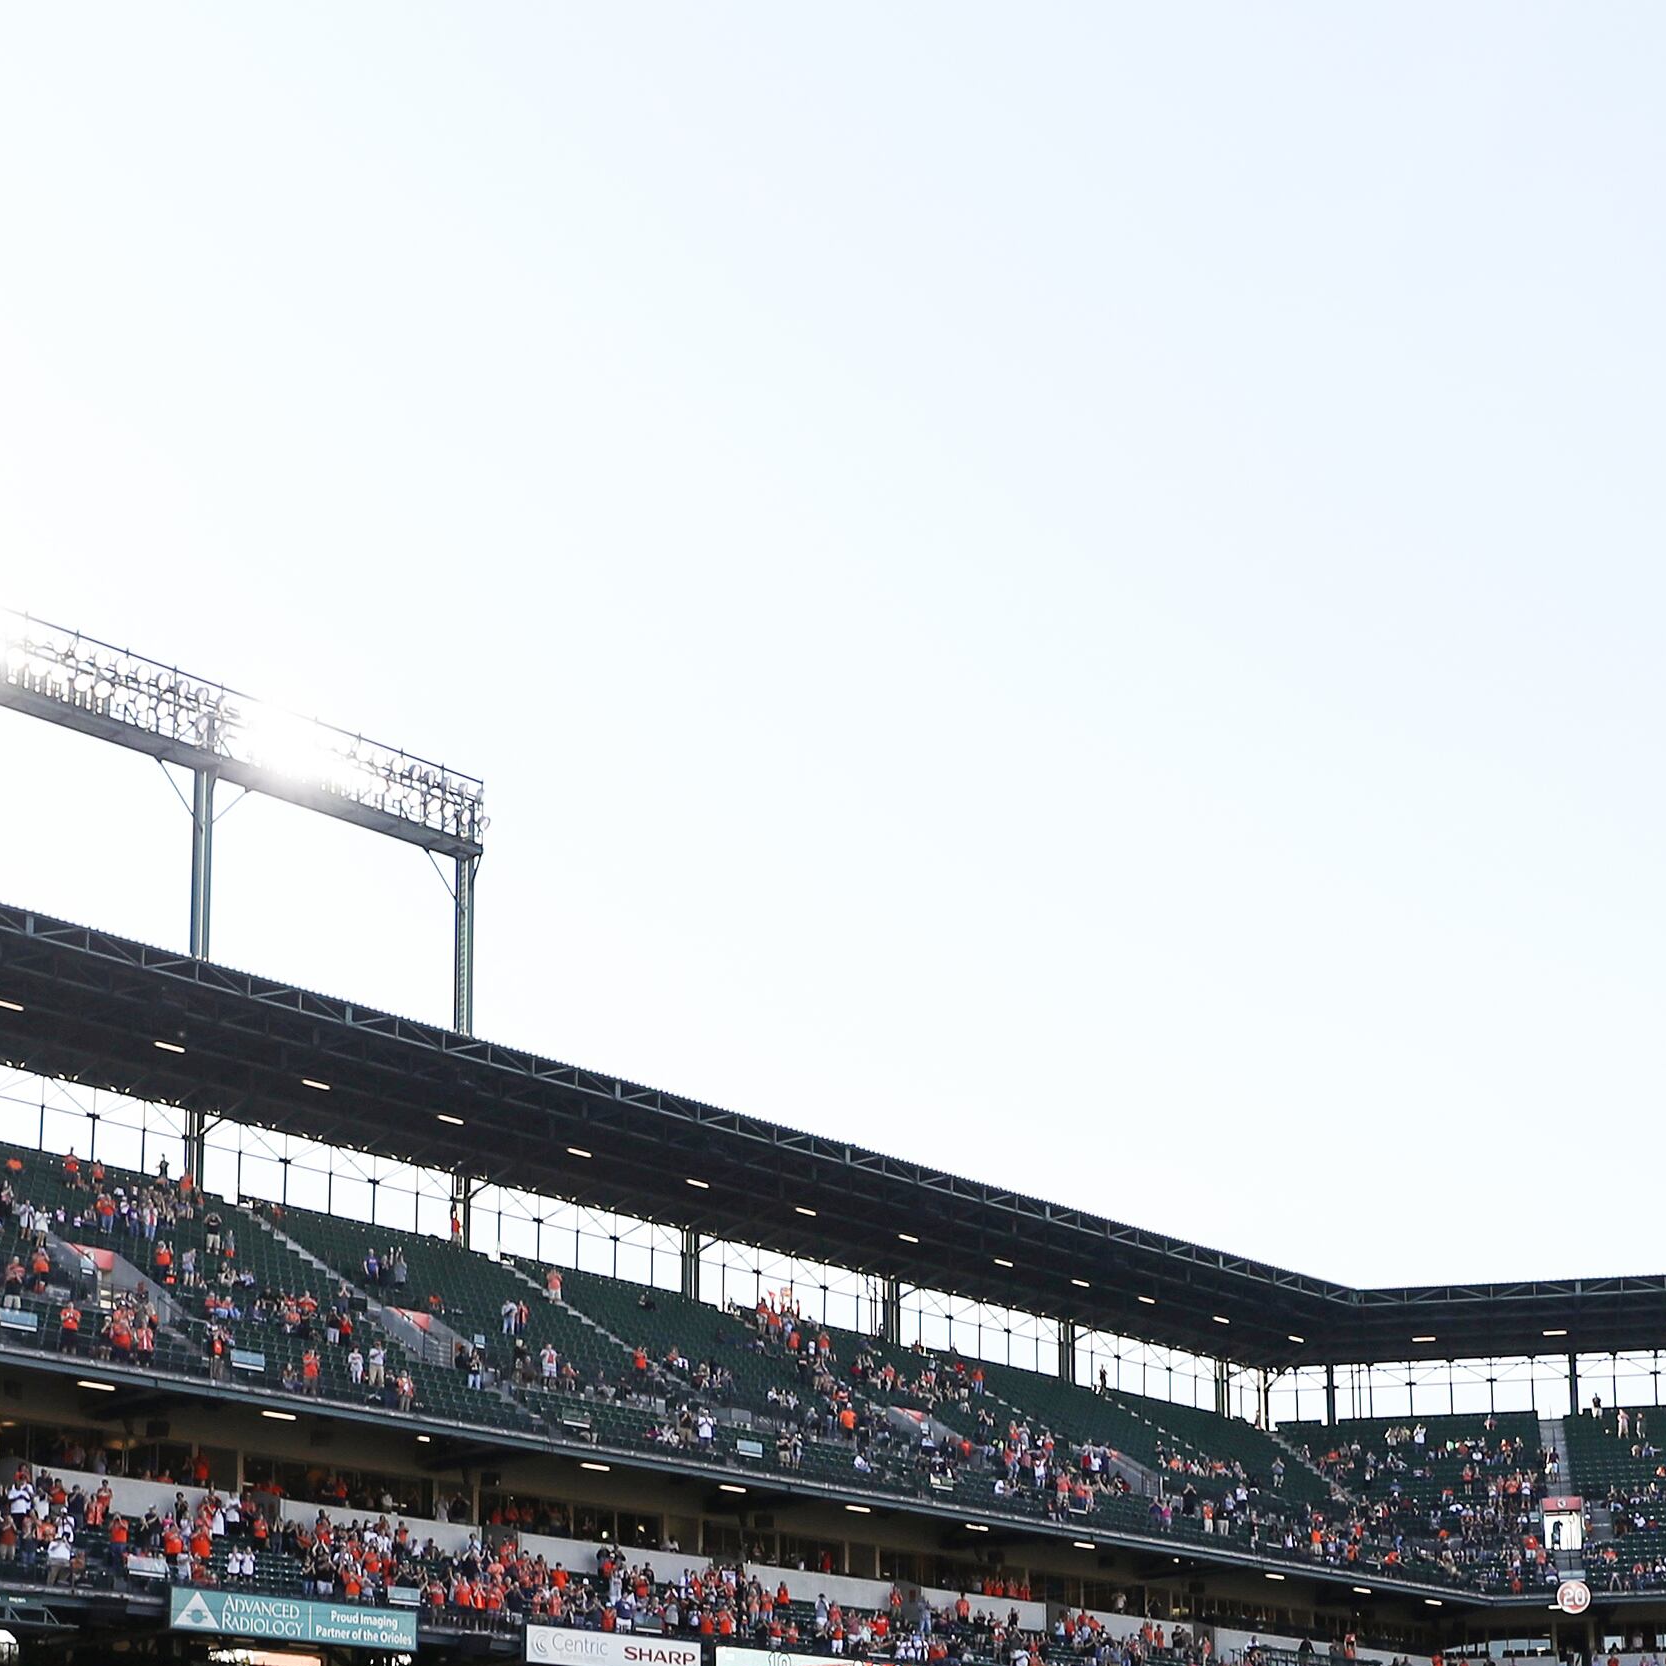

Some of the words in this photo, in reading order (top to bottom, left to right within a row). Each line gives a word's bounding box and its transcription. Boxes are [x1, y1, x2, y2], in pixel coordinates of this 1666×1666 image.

[222, 1594, 301, 1620] ADVANCED
[1562, 1587, 1584, 1607] 20
[222, 1612, 304, 1638] RADIOLOGY
[331, 1610, 359, 1624] Proud
[360, 1615, 398, 1630] Imaging
[315, 1625, 350, 1640] Partner
[351, 1628, 362, 1640] of
[363, 1630, 379, 1642] the
[380, 1631, 412, 1646] Orioles
[552, 1632, 609, 1656] Centric
[624, 1646, 696, 1666] SHARP
